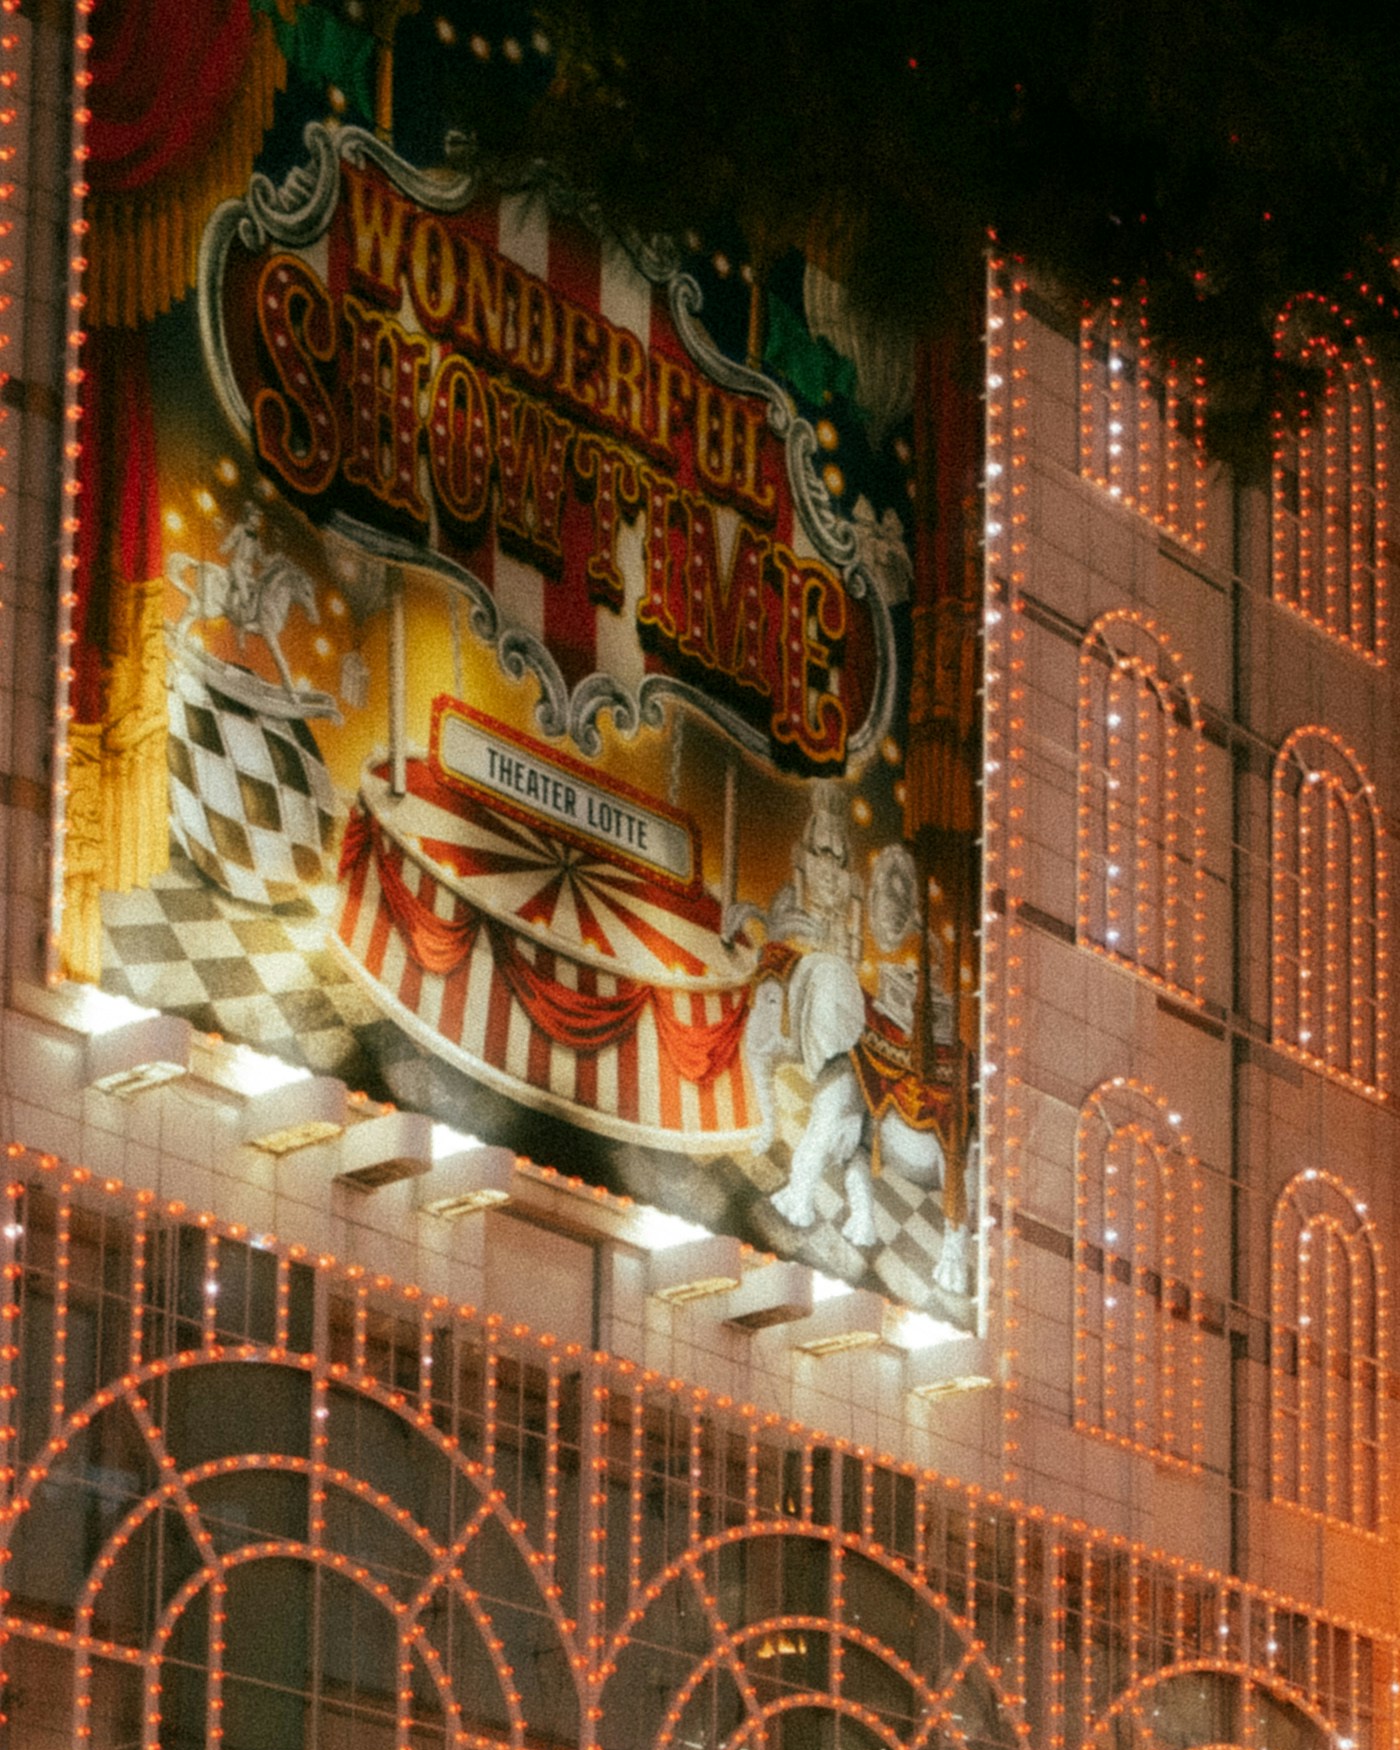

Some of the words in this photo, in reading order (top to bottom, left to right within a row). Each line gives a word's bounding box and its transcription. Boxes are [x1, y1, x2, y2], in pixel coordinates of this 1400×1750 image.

[347, 172, 776, 506] WONDERFUL
[255, 253, 847, 762] SHOWTIME
[485, 747, 578, 820] THEATER
[586, 798, 649, 851] LOTTE
